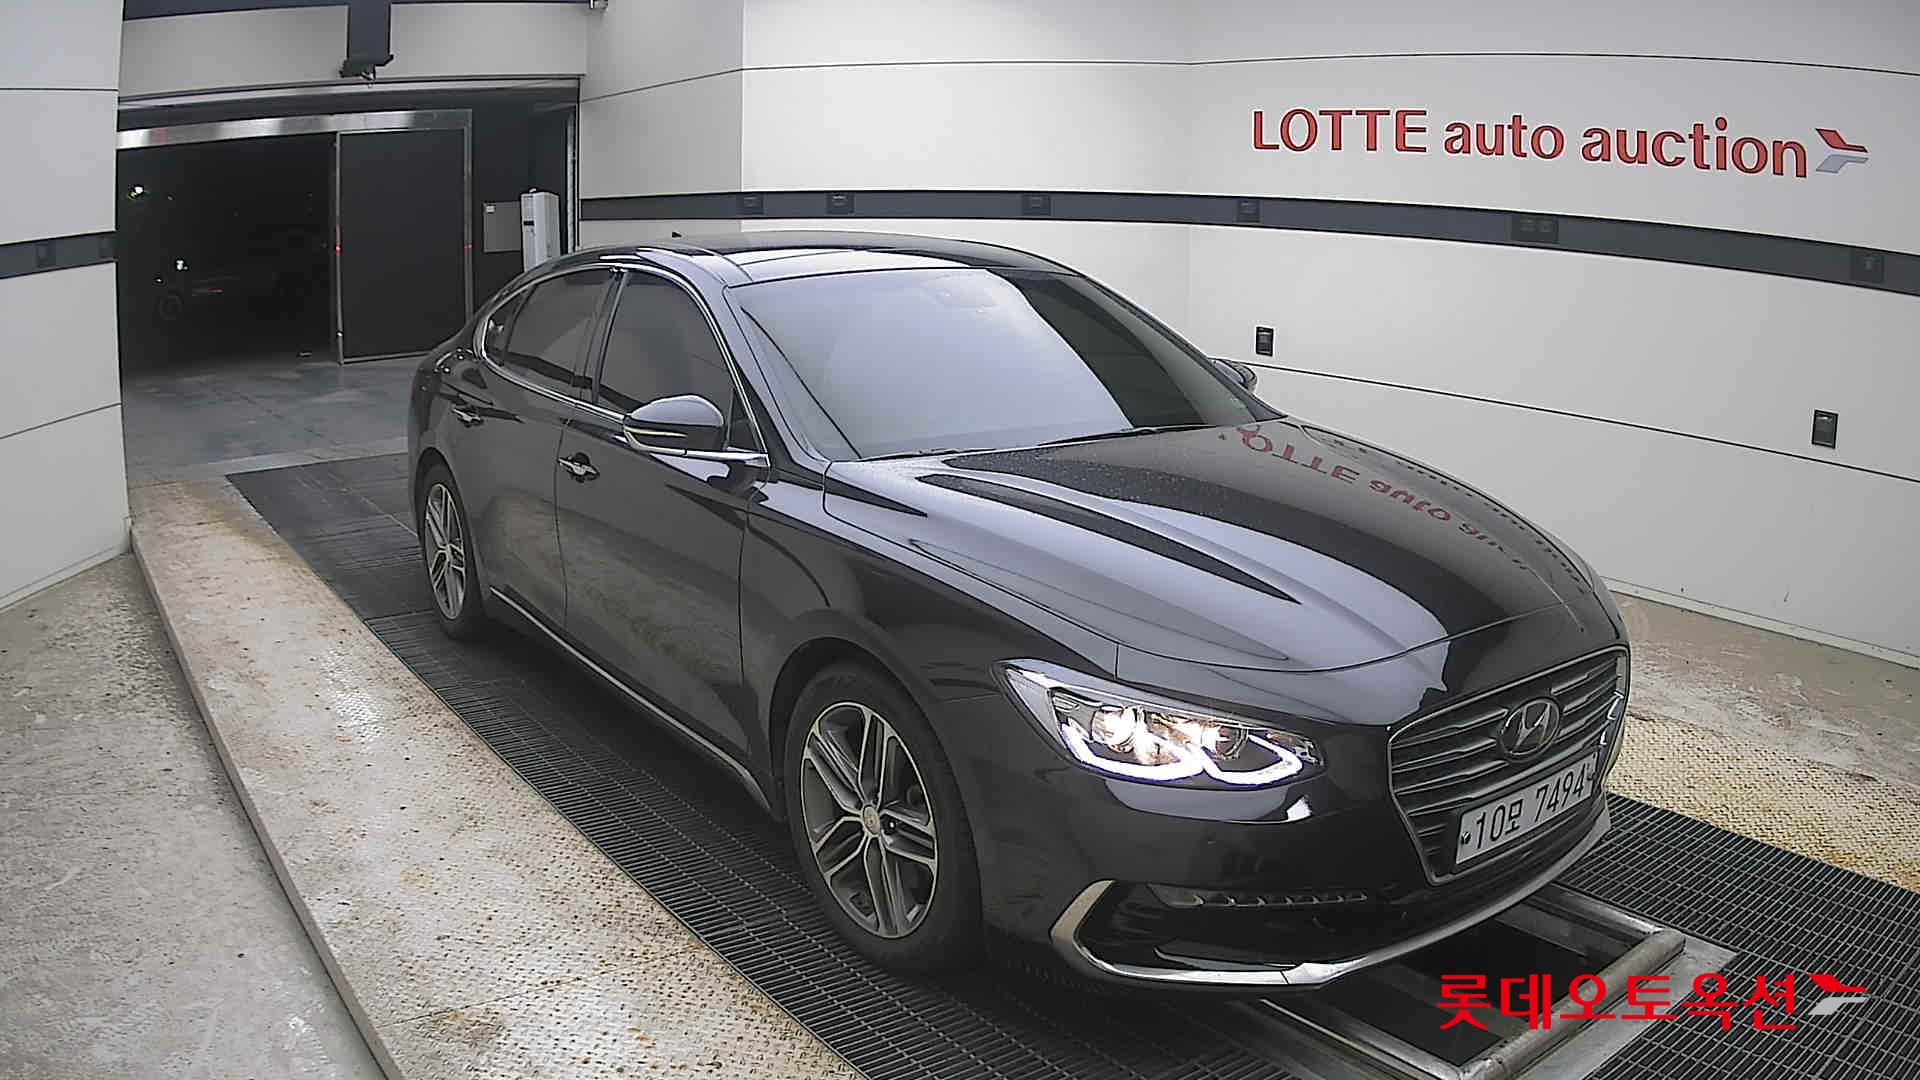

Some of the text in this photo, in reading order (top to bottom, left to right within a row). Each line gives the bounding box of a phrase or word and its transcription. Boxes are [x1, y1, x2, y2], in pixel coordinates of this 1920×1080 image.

[1253, 108, 1808, 178] LOTTE auto auction
[1535, 762, 1587, 823] 7494
